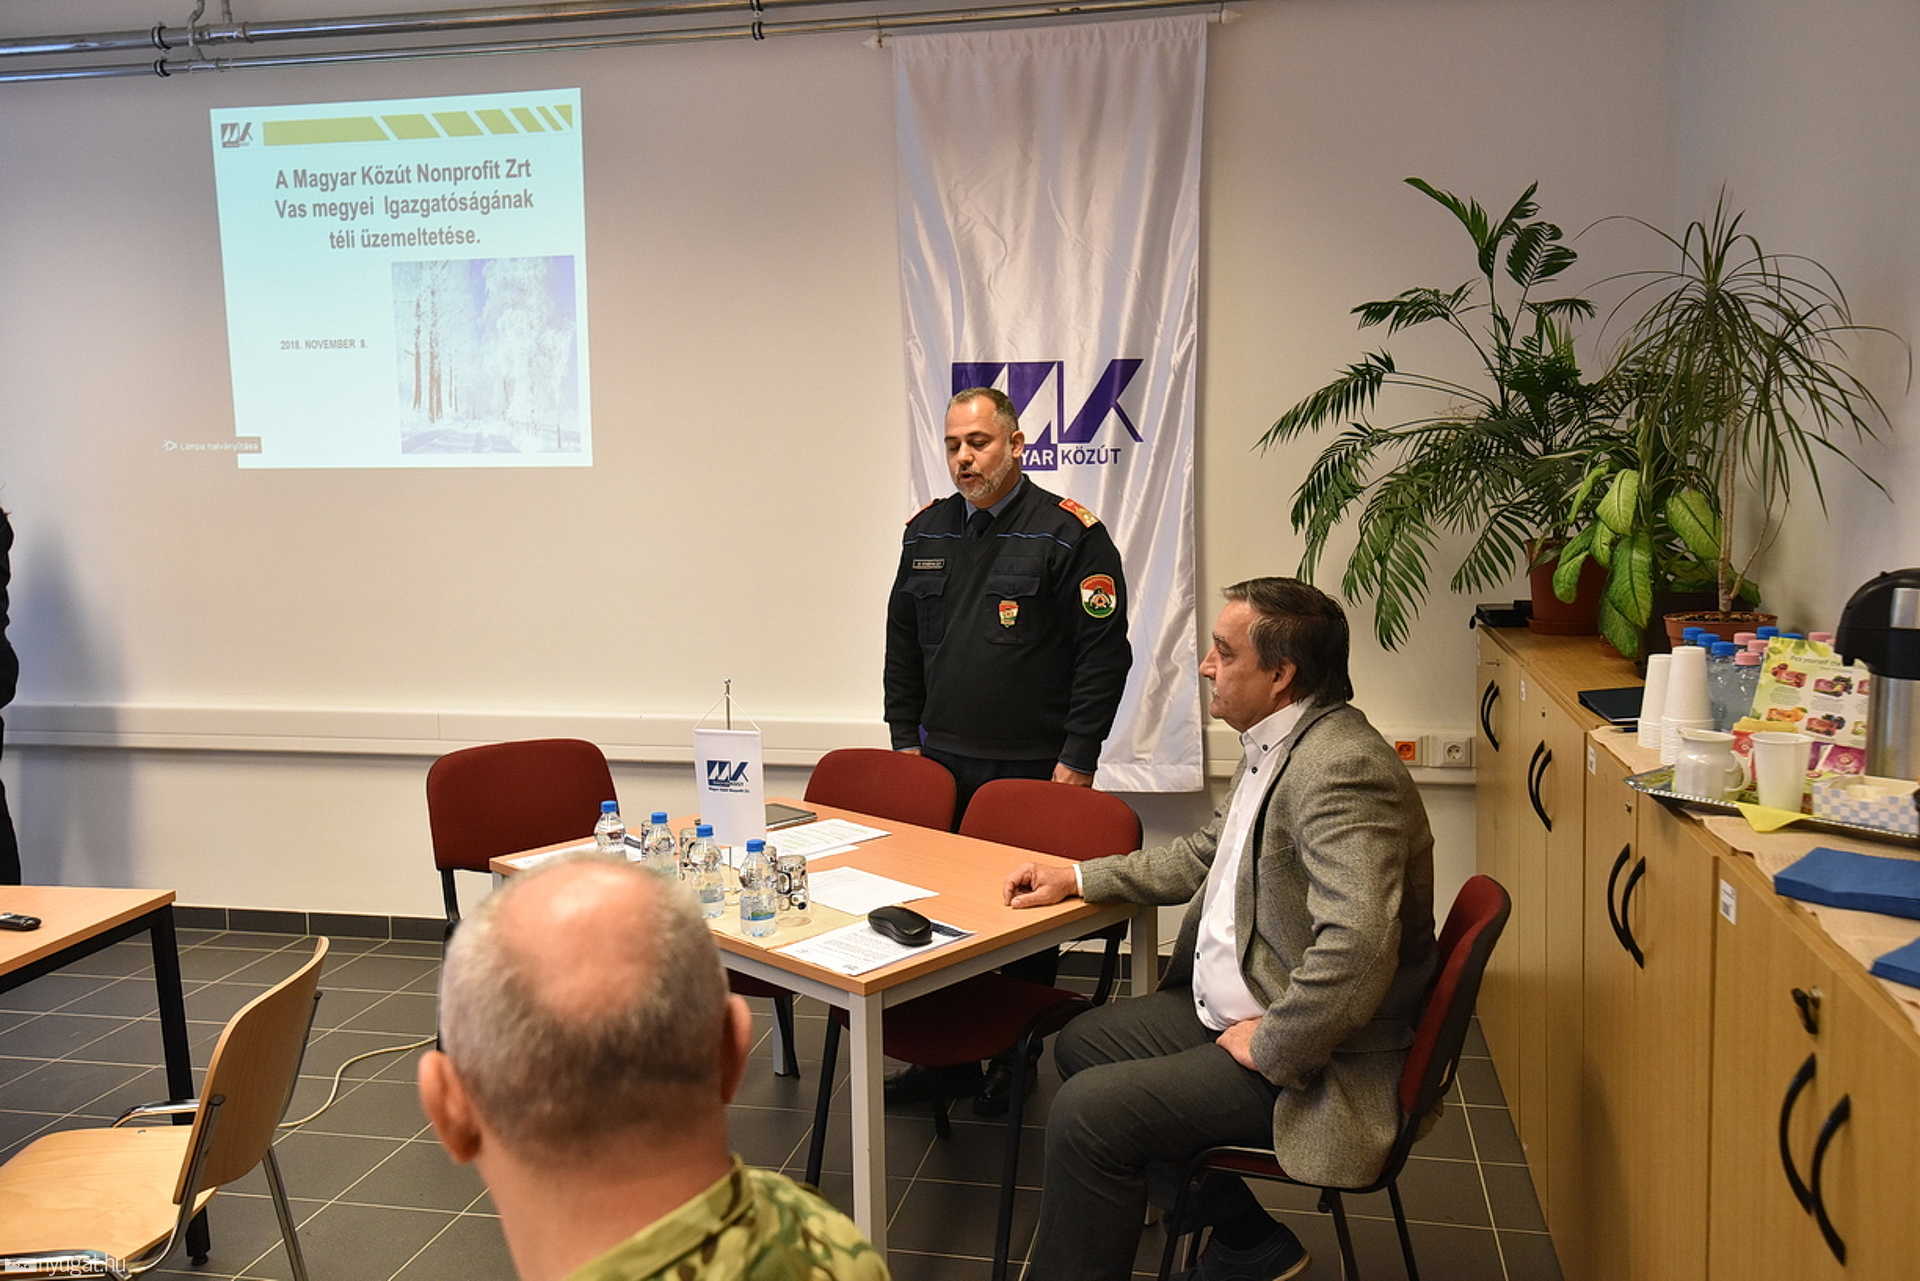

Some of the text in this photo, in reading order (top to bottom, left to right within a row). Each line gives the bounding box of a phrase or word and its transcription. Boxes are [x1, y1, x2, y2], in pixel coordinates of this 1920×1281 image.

[276, 158, 532, 192] A Magyar Közút Nonprofit Zrt
[275, 189, 534, 221] Vas megyei Igazgatóságának
[329, 226, 481, 249] téli üzemeltetése.
[305, 339, 356, 349] NOVEMBER
[1021, 444, 1121, 465] YAR KÖZÚT
